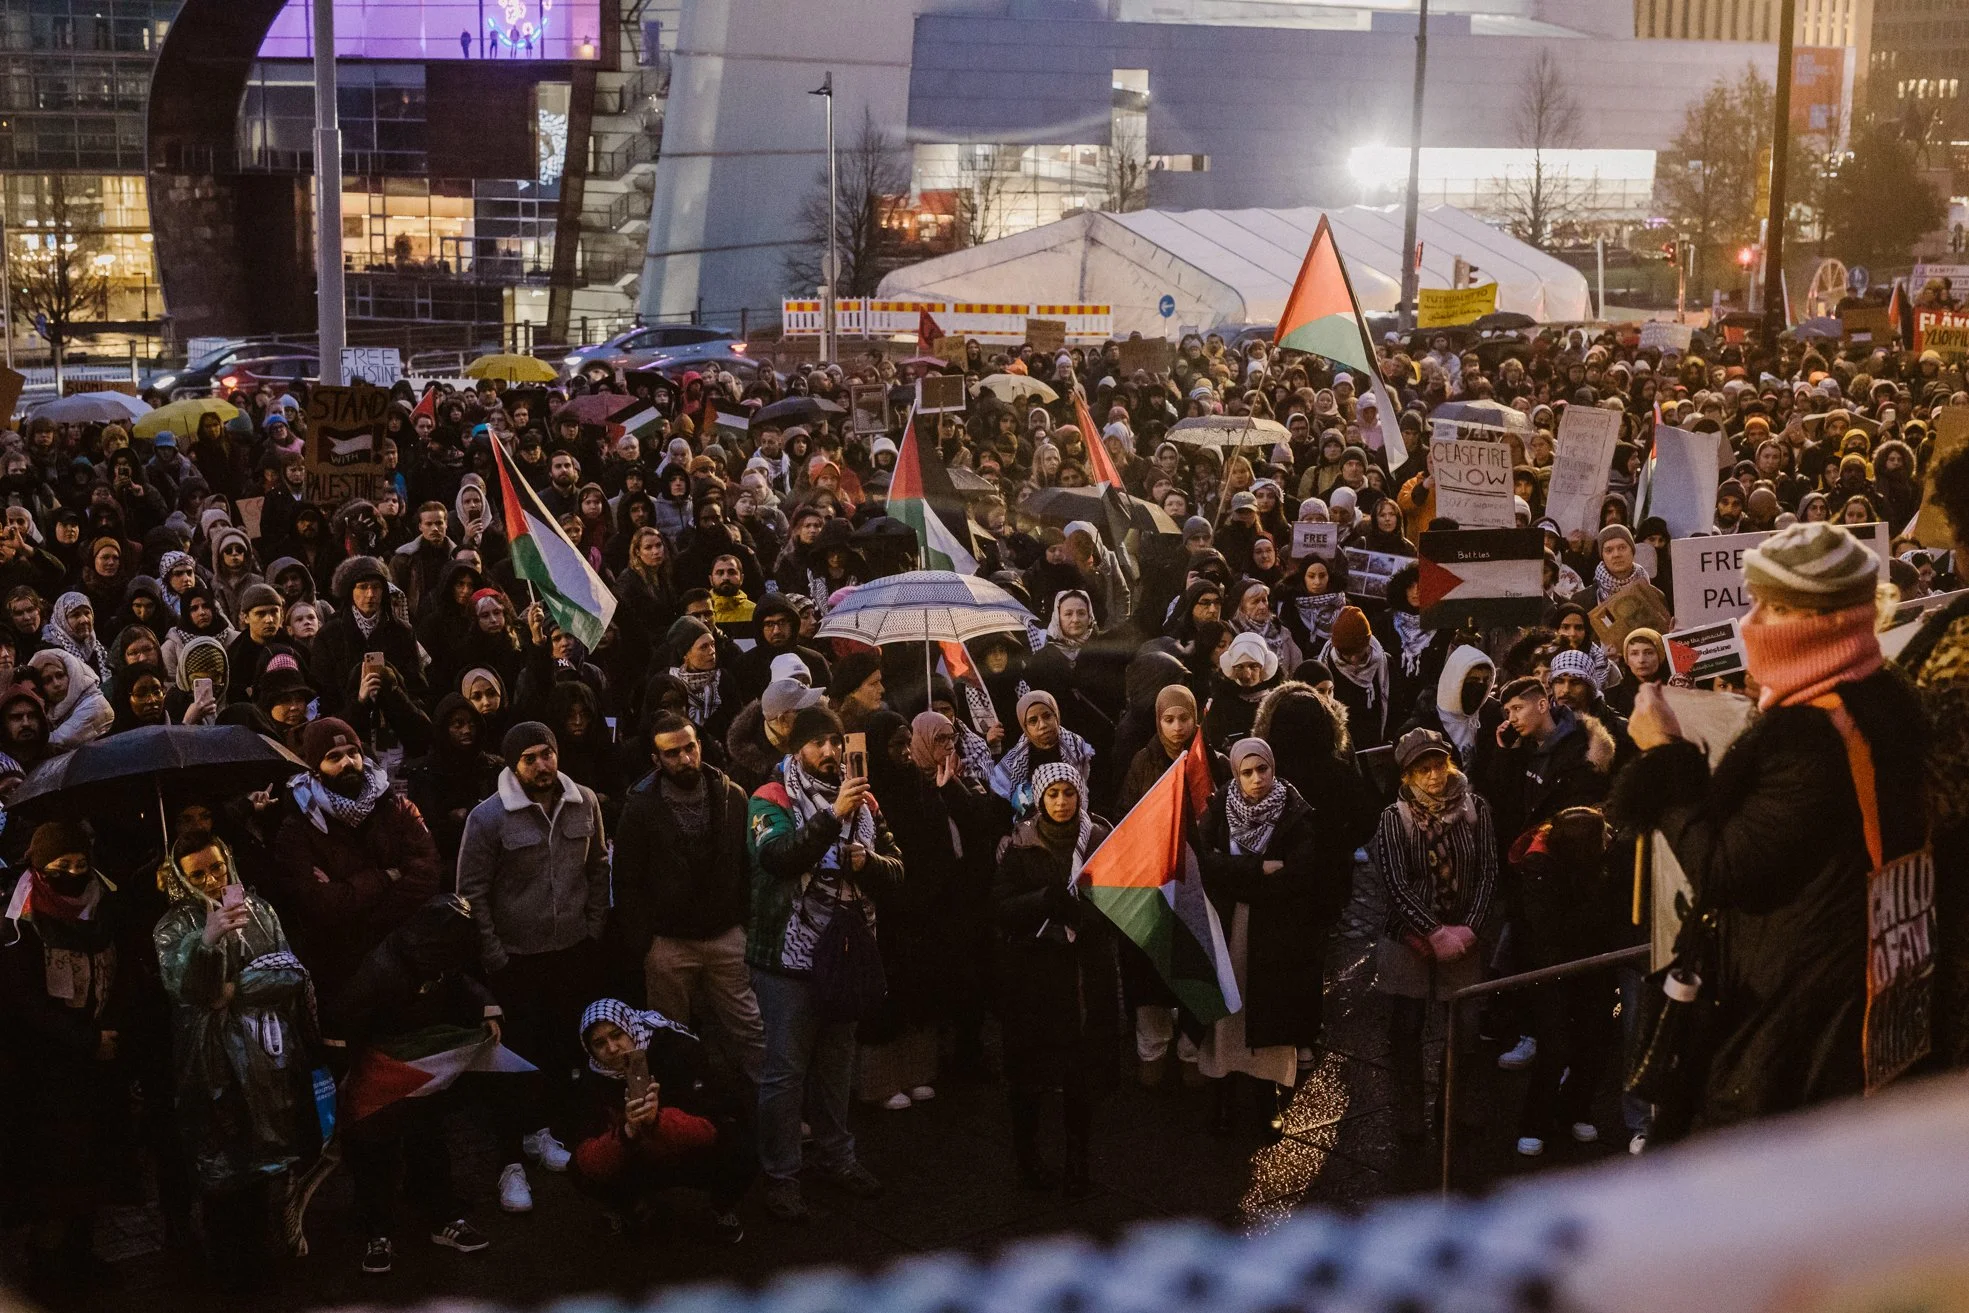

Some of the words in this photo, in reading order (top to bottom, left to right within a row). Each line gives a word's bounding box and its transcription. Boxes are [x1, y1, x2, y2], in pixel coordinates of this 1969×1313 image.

[340, 349, 395, 366] FREE
[342, 365, 399, 385] PALESTINE
[312, 389, 388, 422] STAND
[330, 453, 359, 465] WITH
[1432, 442, 1509, 469] CEASEFIRE
[306, 471, 384, 501] PALESTINE
[1439, 468, 1507, 486] NOW
[1303, 533, 1328, 543] FREE
[1701, 549, 1744, 573] FRE
[1704, 586, 1750, 609] PAL
[1871, 855, 1936, 940] CHILD
